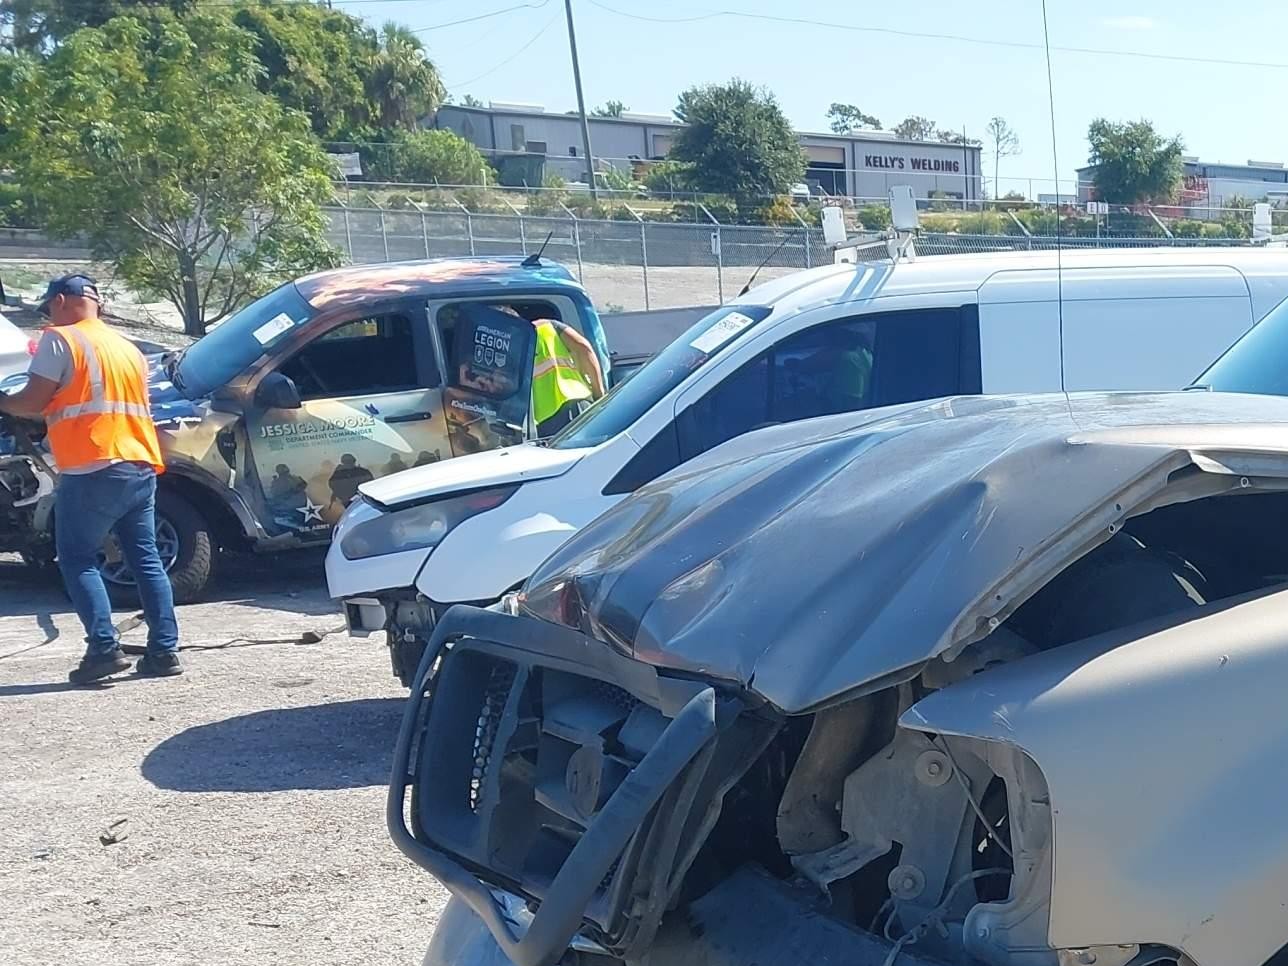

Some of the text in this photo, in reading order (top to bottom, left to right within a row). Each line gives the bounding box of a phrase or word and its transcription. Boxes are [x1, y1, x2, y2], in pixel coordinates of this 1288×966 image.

[865, 155, 960, 172] KELLY'S WELDING
[474, 331, 510, 352] LEGION
[260, 415, 377, 438] JESSICA MOORE
[285, 433, 328, 443] DEPARTMENT
[328, 428, 373, 439] COMMANDER
